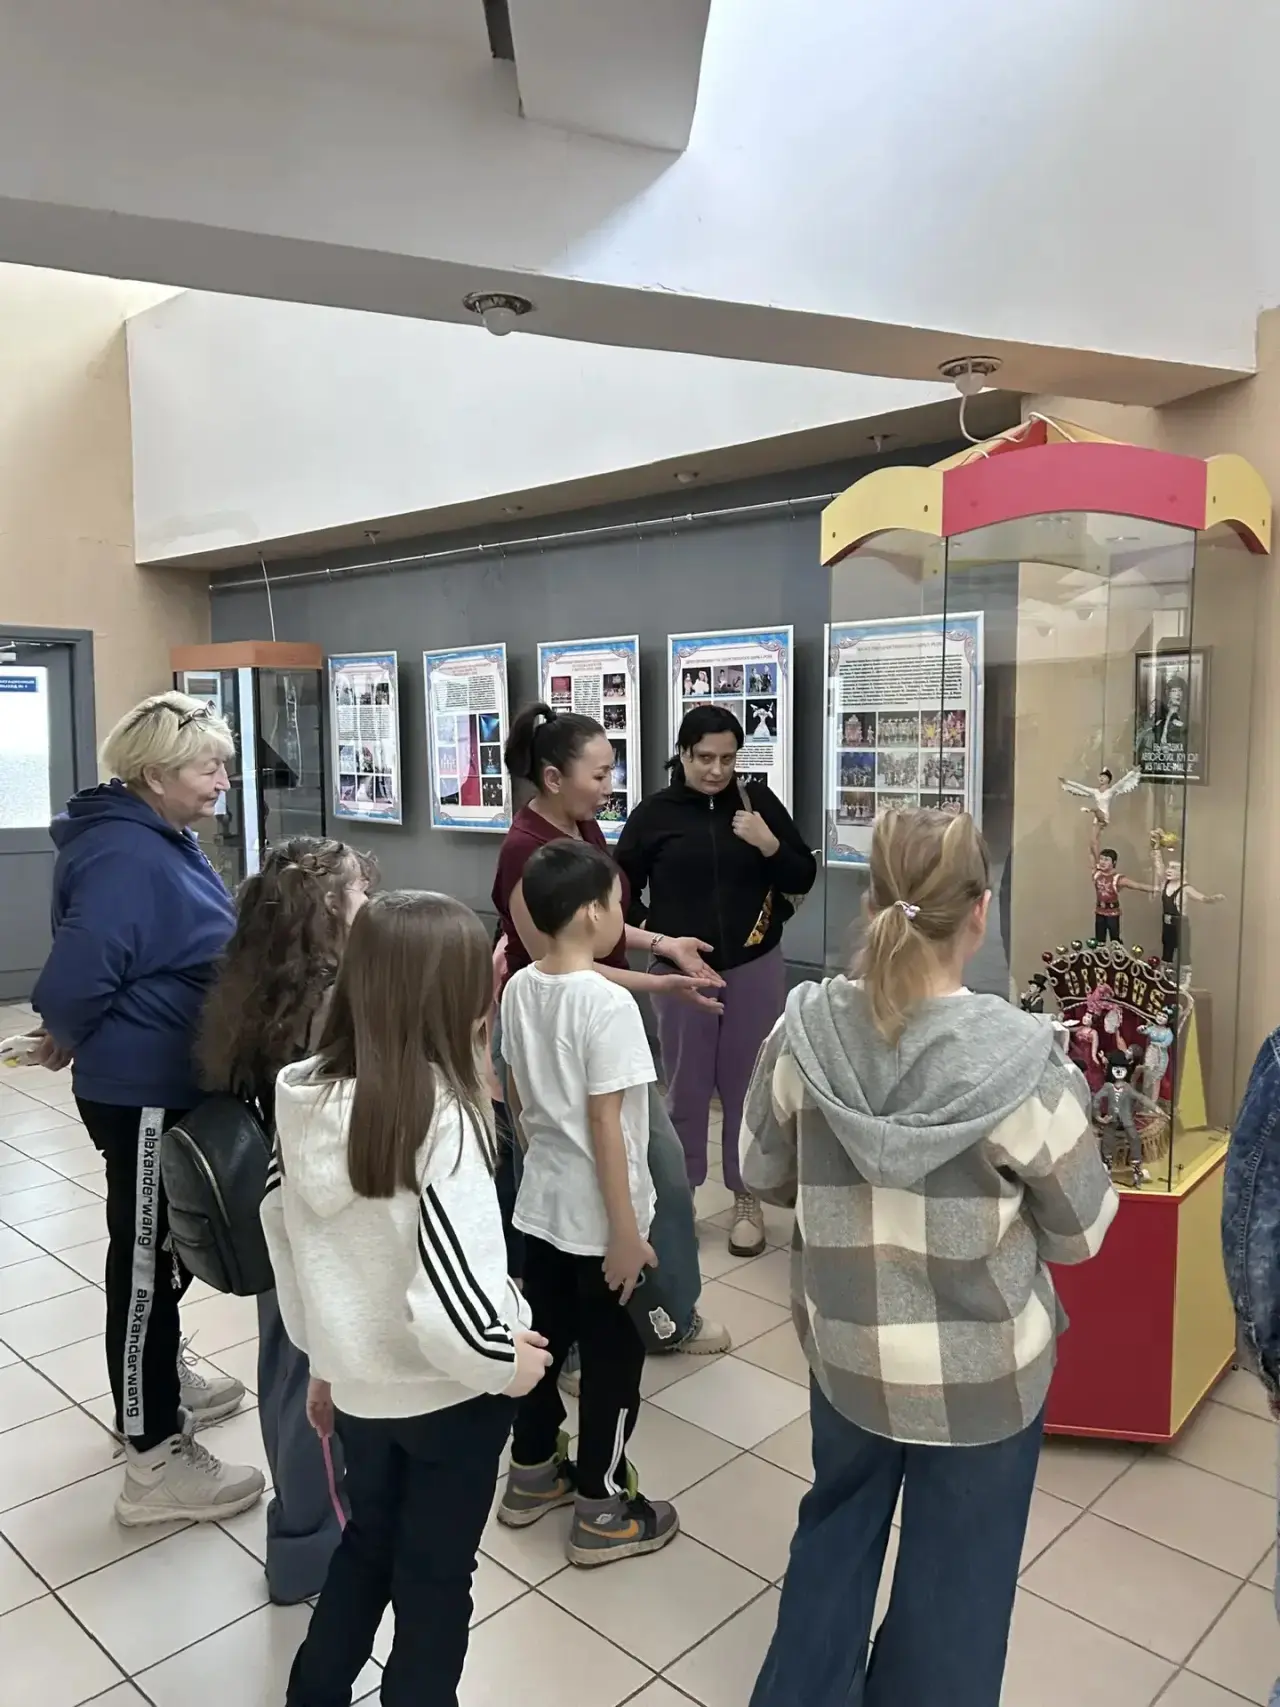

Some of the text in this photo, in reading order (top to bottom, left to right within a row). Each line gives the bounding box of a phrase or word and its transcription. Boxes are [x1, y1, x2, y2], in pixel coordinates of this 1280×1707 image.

[1064, 967, 1165, 1014] CIRCUS
[138, 1127, 158, 1246] alexanderwang
[127, 1288, 148, 1418] alexanderwang
